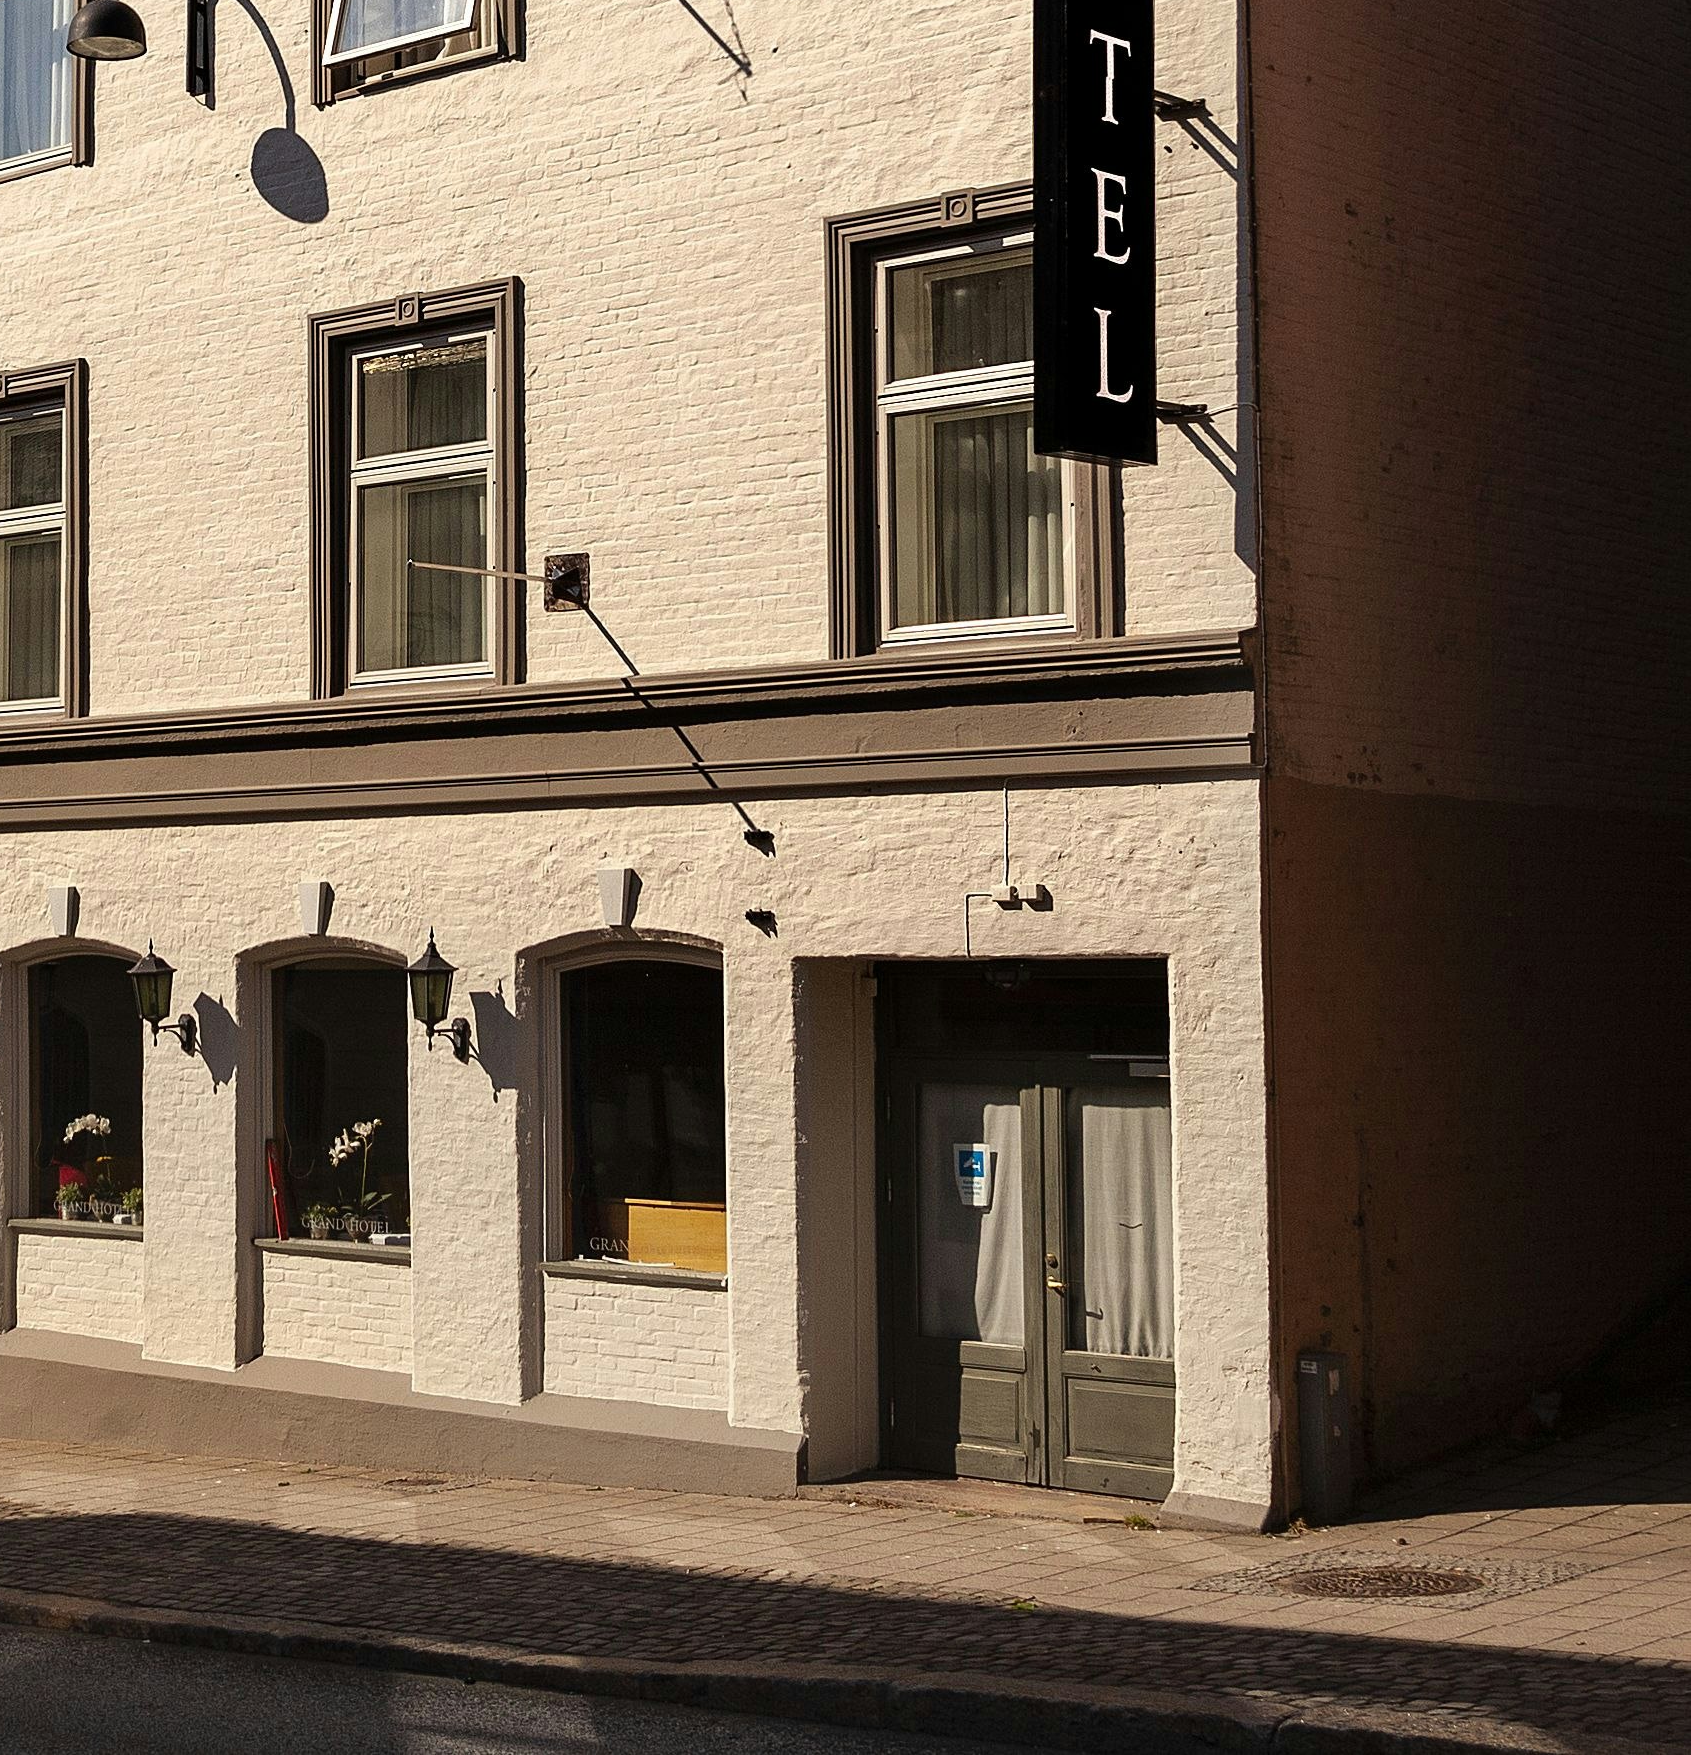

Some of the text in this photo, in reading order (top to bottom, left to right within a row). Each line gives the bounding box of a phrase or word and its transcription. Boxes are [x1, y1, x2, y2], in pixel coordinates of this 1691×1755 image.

[301, 1215, 392, 1234] GRAND HOTEL
[589, 1236, 629, 1252] GRAN
